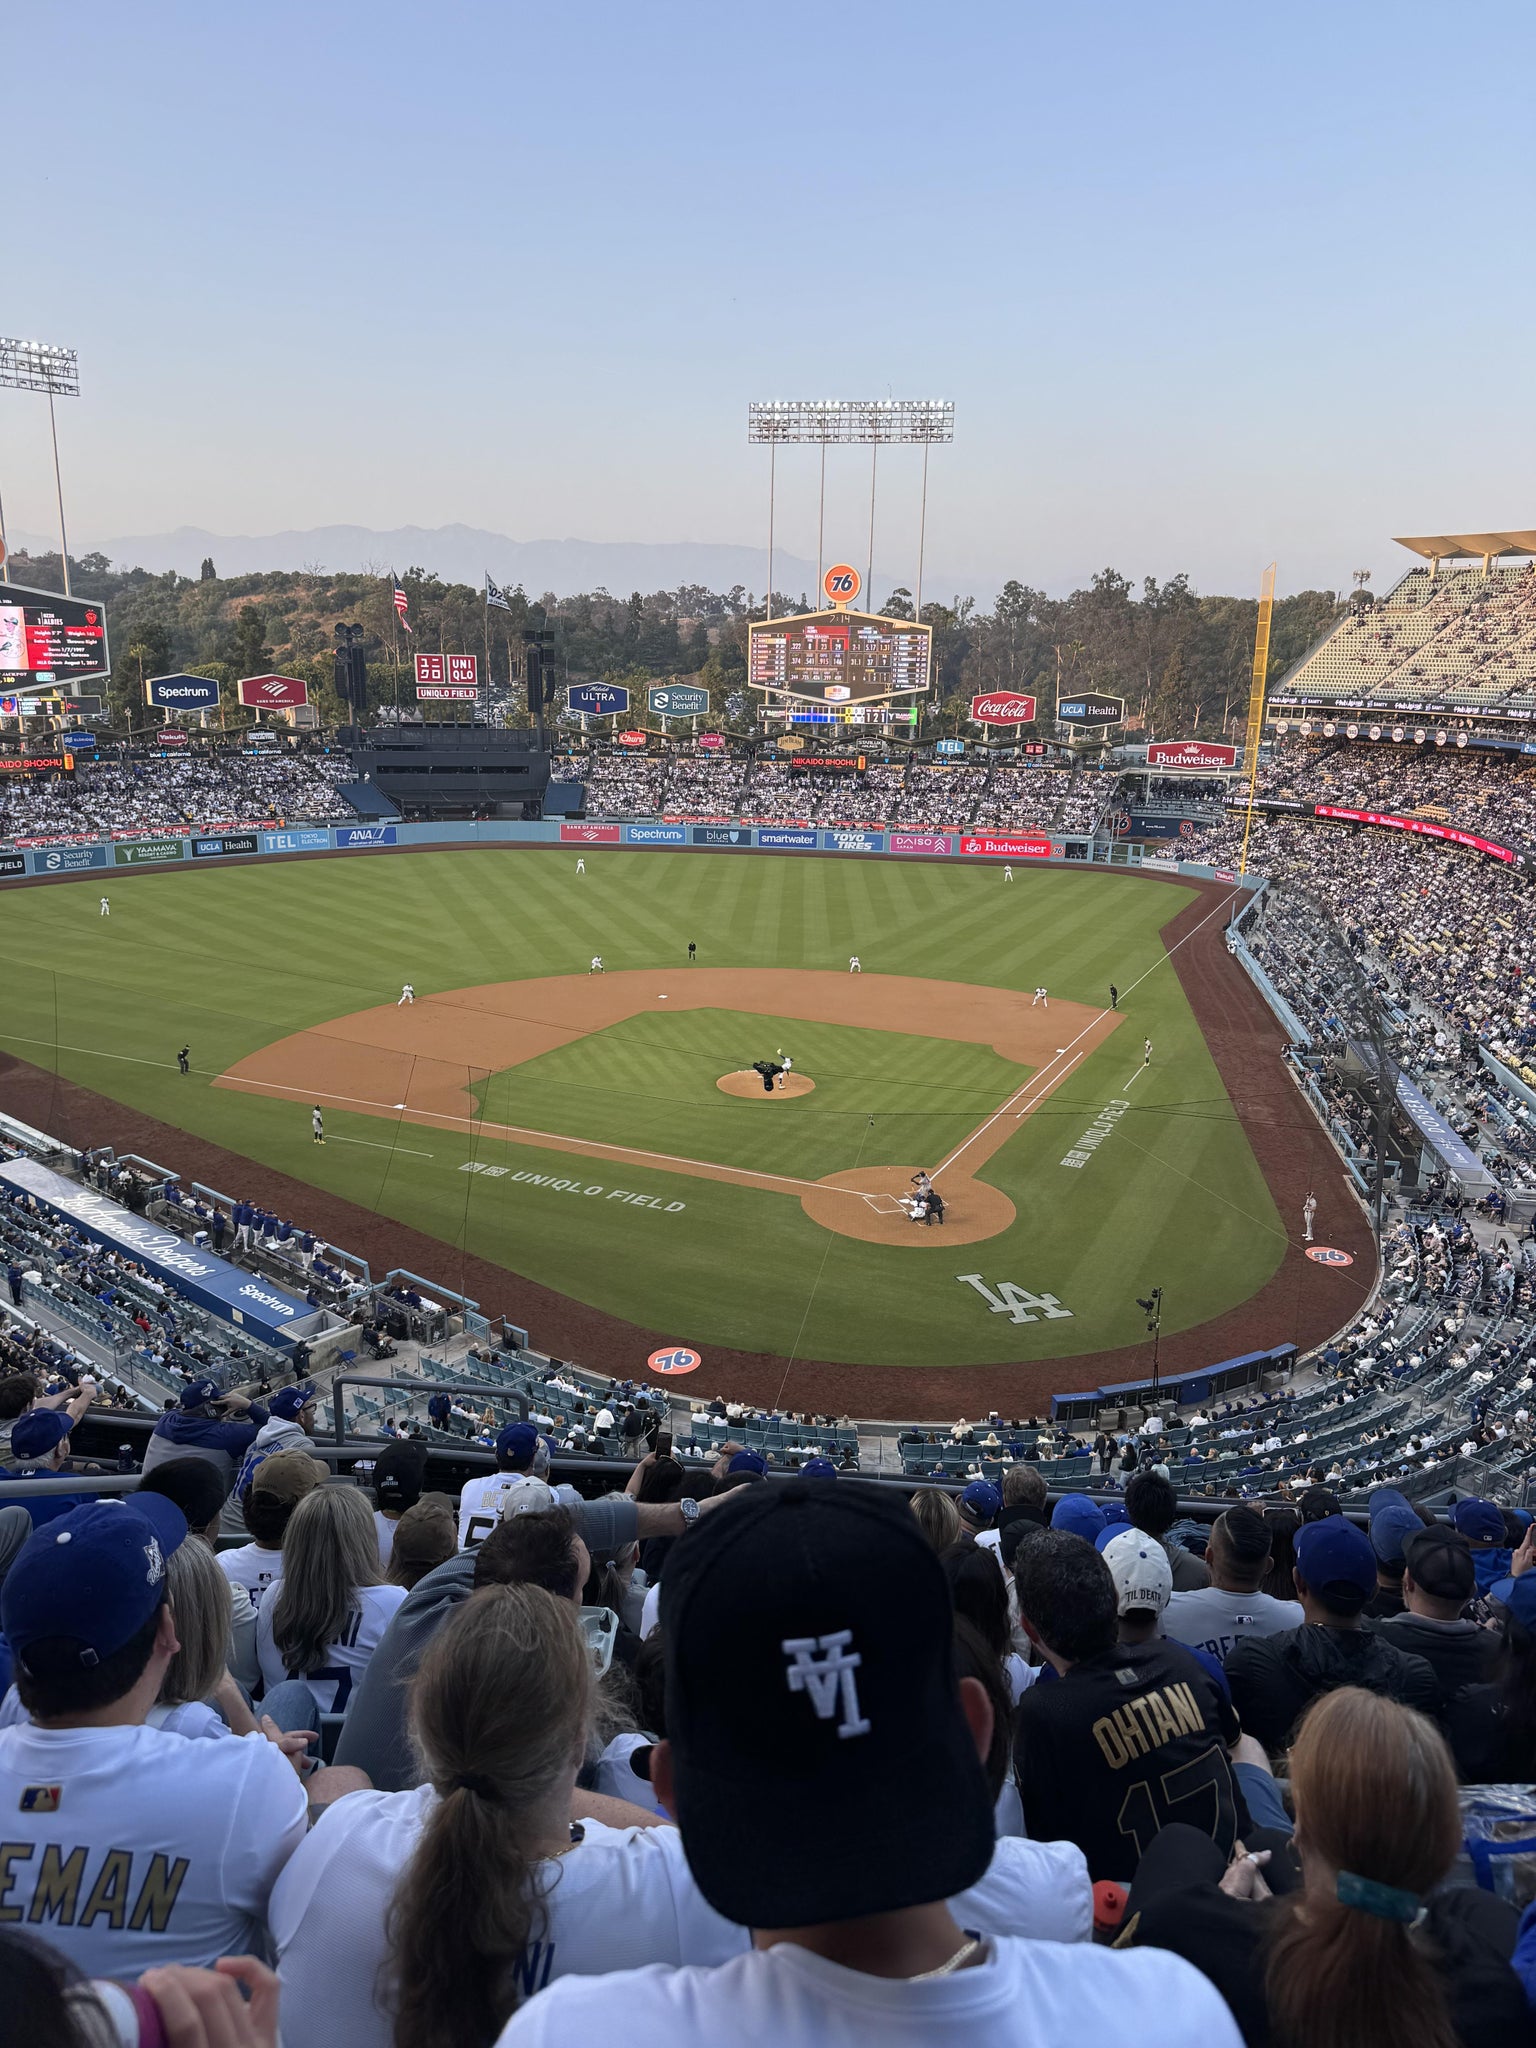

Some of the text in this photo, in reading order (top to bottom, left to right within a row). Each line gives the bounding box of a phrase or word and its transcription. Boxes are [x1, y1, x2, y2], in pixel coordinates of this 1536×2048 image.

[830, 574, 853, 592] 76
[829, 615, 850, 623] 7:14
[452, 659, 471, 669] UNI
[453, 670, 473, 681] QLO
[158, 686, 209, 699] Spectrum
[421, 690, 449, 698] UNIQLO
[581, 693, 615, 701] ULTRA
[672, 693, 703, 703] Security
[978, 700, 1030, 718] Coca-Cola
[1062, 706, 1083, 714] UCLA
[1088, 705, 1117, 716] Health
[874, 713, 878, 722] 2
[882, 713, 885, 722] 1
[620, 734, 645, 743] Churu
[940, 742, 960, 752] TEL
[23, 759, 62, 767] SHOCHU
[793, 758, 824, 766] NIKAIDO
[1332, 810, 1360, 820] Budweiser
[1380, 817, 1404, 827] Budweiser
[1182, 823, 1193, 832] 76
[349, 830, 372, 840] ANA
[631, 829, 679, 840] Spectrum
[707, 830, 728, 839] blue
[761, 835, 814, 844] smartwater
[833, 833, 865, 842] TOYO
[225, 840, 252, 850] Health
[266, 835, 296, 849] TEL
[838, 841, 872, 850] TIRES
[985, 841, 1046, 853] Budweiser
[63, 850, 94, 859] Security
[1053, 846, 1063, 854] 76
[0, 861, 23, 869] FIELD
[64, 859, 90, 868] Benefit
[1098, 1100, 1130, 1122] FIELD
[1404, 1099, 1445, 1134] DODGER
[1074, 1121, 1114, 1150] UNIQLO
[511, 1171, 687, 1213] UNIQLO FIELD
[53, 1194, 216, 1277] Los Angeles Dodgers
[1312, 1249, 1348, 1263] 76
[239, 1284, 294, 1315] Spectrum
[956, 1273, 1074, 1324] LA
[655, 1350, 694, 1371] 76
[1140, 1589, 1162, 1604] DEATH
[781, 1629, 871, 1740] LA
[1092, 1682, 1206, 1770] OHTANI
[1117, 1744, 1237, 1865] 17
[0, 1842, 190, 1932] EMAN
